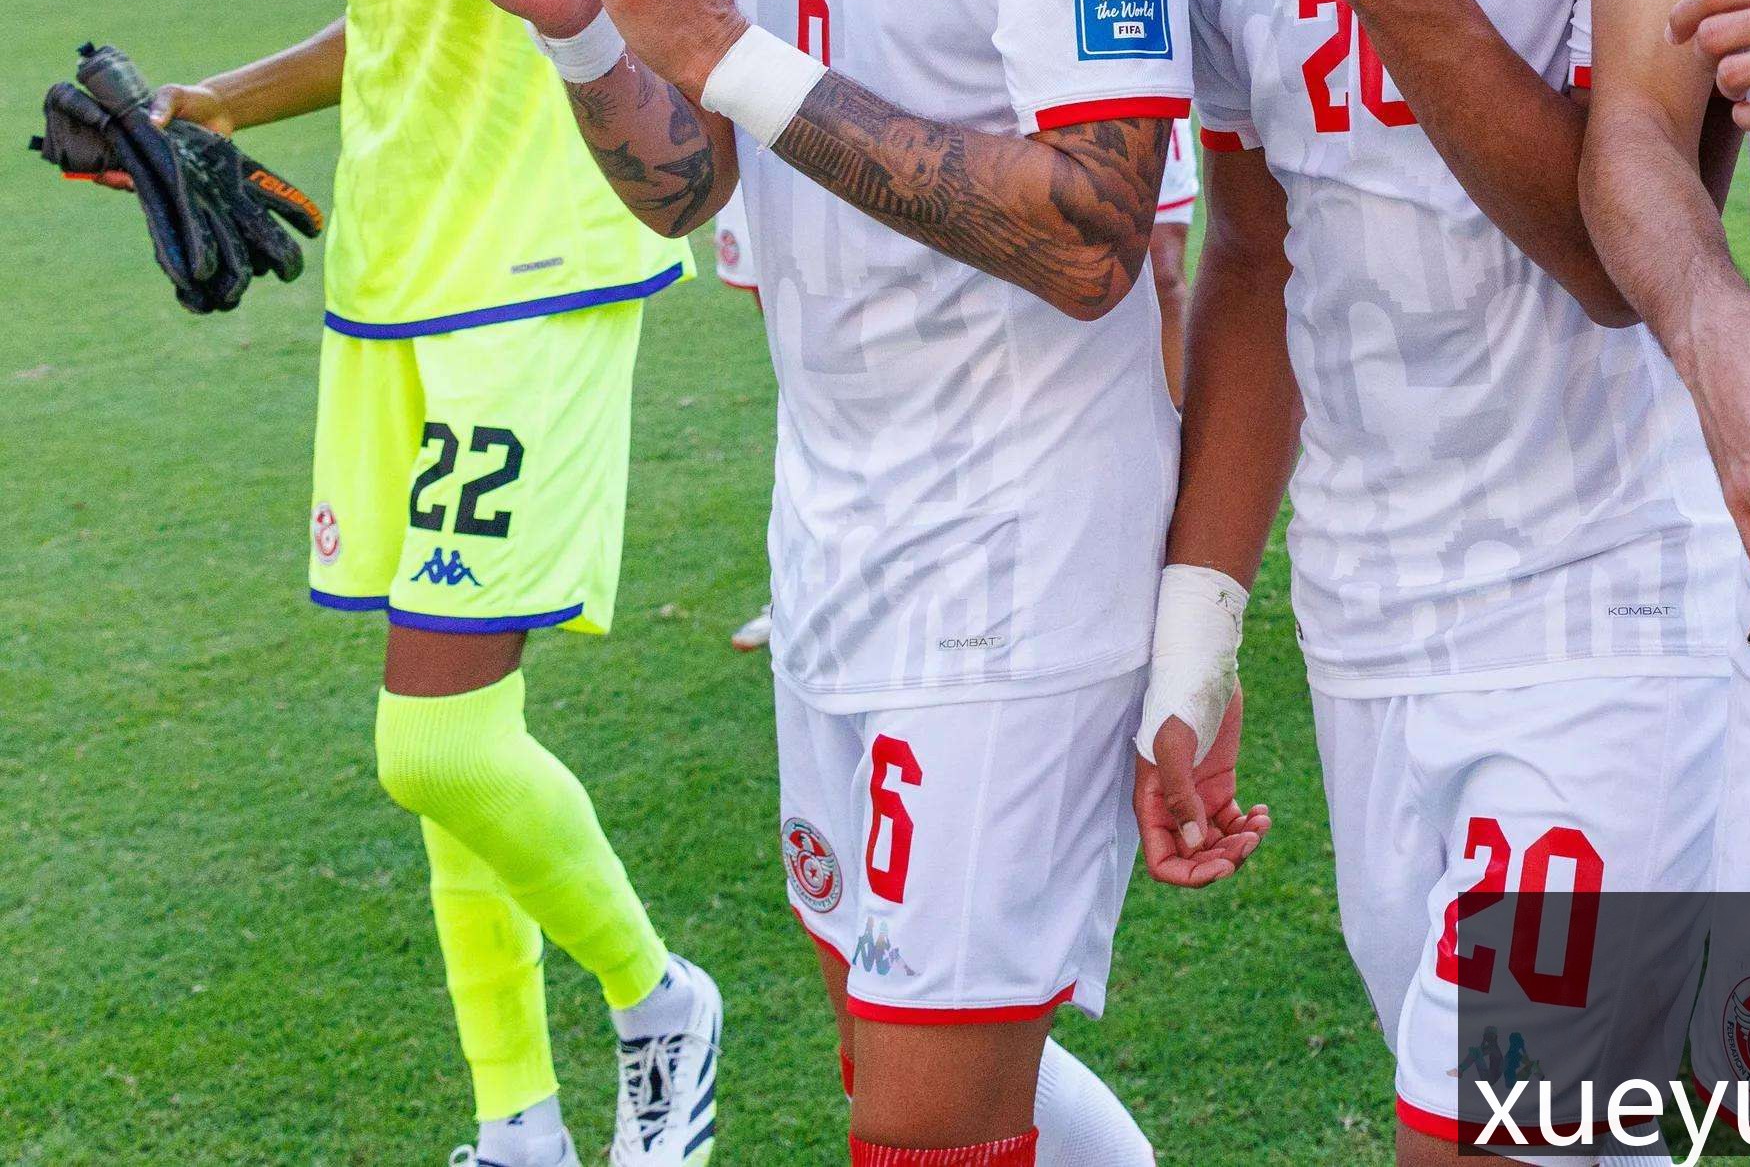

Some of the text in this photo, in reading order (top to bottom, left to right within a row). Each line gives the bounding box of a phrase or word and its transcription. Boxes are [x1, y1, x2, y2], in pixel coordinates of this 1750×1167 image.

[1094, 1, 1154, 20] the World
[1118, 25, 1142, 35] FIFA
[410, 421, 525, 538] 22
[1608, 606, 1673, 616] KOMBAT
[939, 636, 999, 649] KOMBAT
[865, 733, 923, 905] 6
[1436, 817, 1605, 1009] 20
